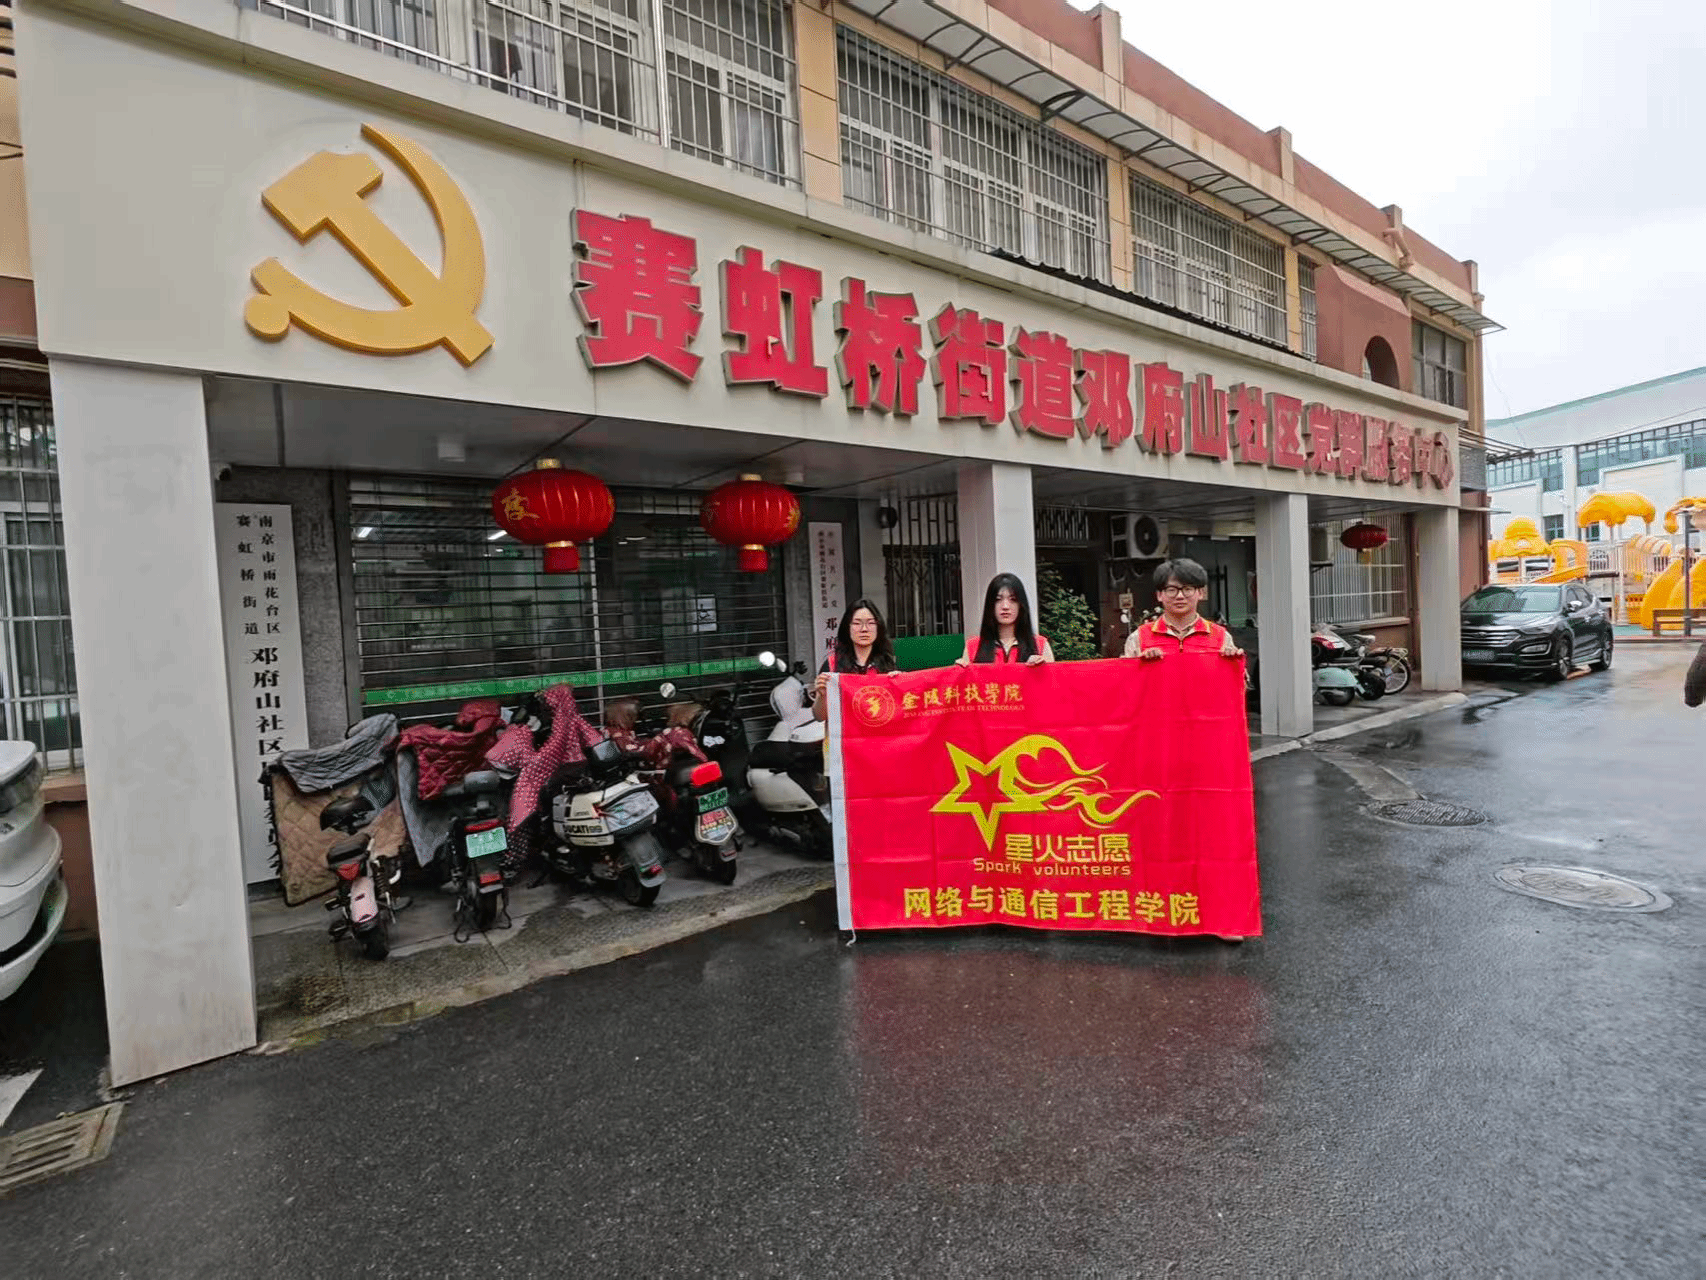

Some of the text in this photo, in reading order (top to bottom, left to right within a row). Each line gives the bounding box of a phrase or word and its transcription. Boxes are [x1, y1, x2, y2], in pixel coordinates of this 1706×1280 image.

[570, 207, 1454, 490] 赛虹桥街道邓府山社区党群服务中心
[235, 513, 260, 636] 赛虹桥街道
[259, 514, 281, 635] 南京市雨花台区
[973, 857, 1132, 877] Spark volunteers
[1004, 832, 1132, 863] 星火志愿
[902, 884, 1201, 927] 网络与通信工程学院
